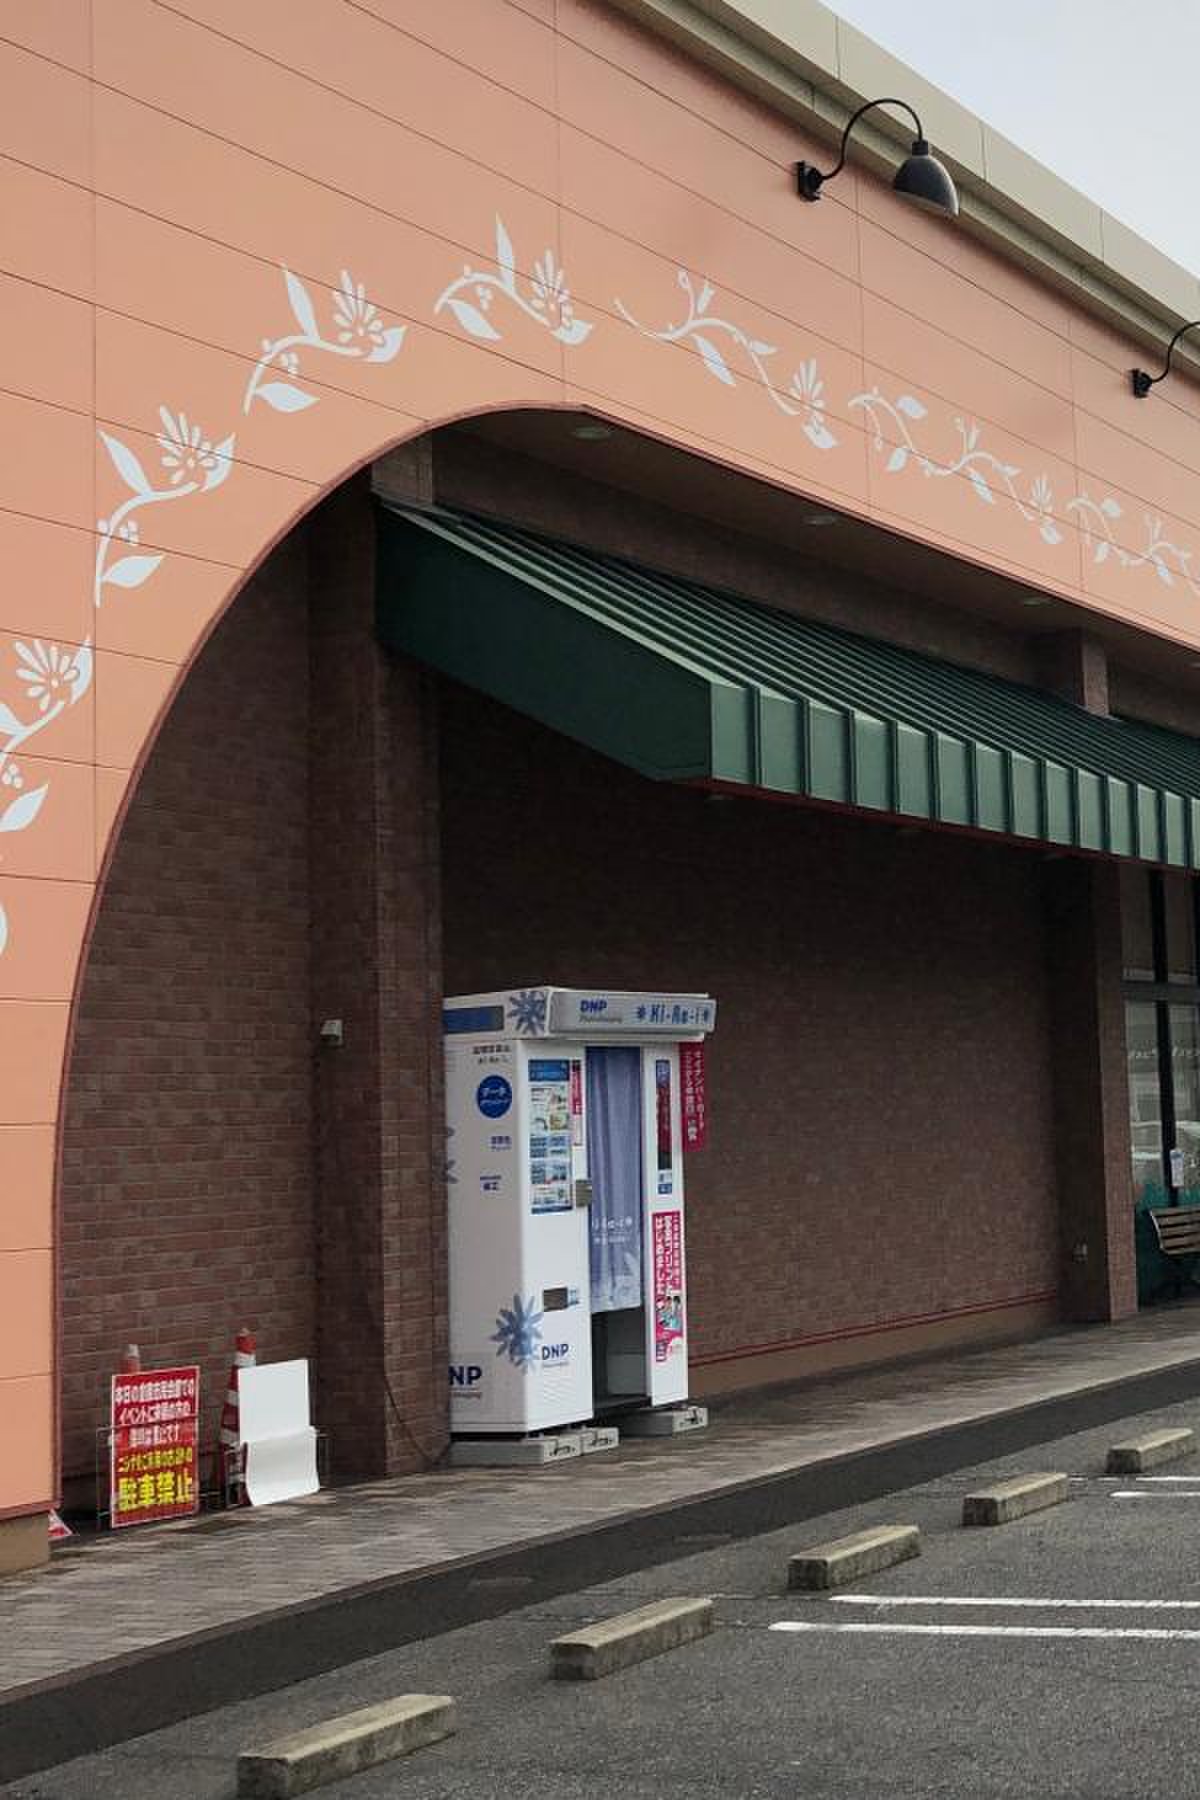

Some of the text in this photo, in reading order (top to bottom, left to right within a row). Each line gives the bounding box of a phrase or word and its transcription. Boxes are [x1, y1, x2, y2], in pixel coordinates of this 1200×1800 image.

[580, 999, 608, 1014] DNP
[541, 1343, 569, 1361] DNP
[448, 1365, 483, 1386] NP
[119, 1470, 193, 1512] 駐車禁止
